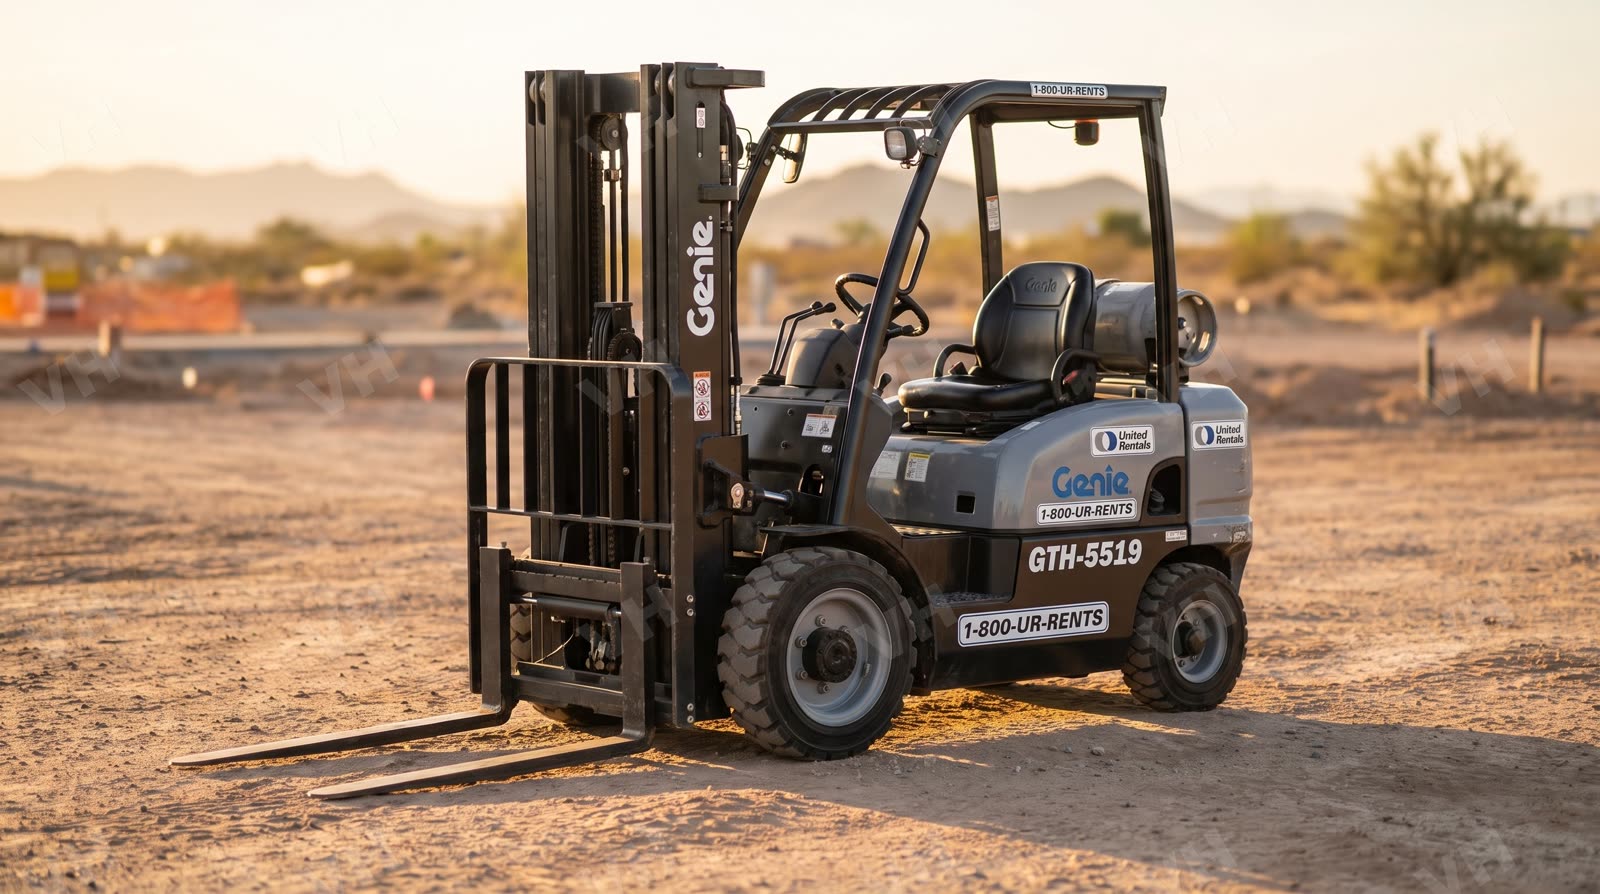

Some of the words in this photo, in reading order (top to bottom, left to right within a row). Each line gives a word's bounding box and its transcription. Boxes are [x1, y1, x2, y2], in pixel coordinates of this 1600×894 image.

[1033, 85, 1105, 97] 1-800-UR-RENTS
[687, 219, 715, 337] Genie
[1118, 430, 1148, 441] United
[1215, 424, 1242, 435] United
[1118, 440, 1152, 451] Rentals
[1216, 434, 1244, 445] Rentals
[1052, 464, 1130, 499] Genie
[1040, 502, 1133, 521] 1-800-UR-RENTS
[1028, 538, 1143, 573] GTH-5519
[964, 609, 1104, 639] 1-800-UR-RENTS
